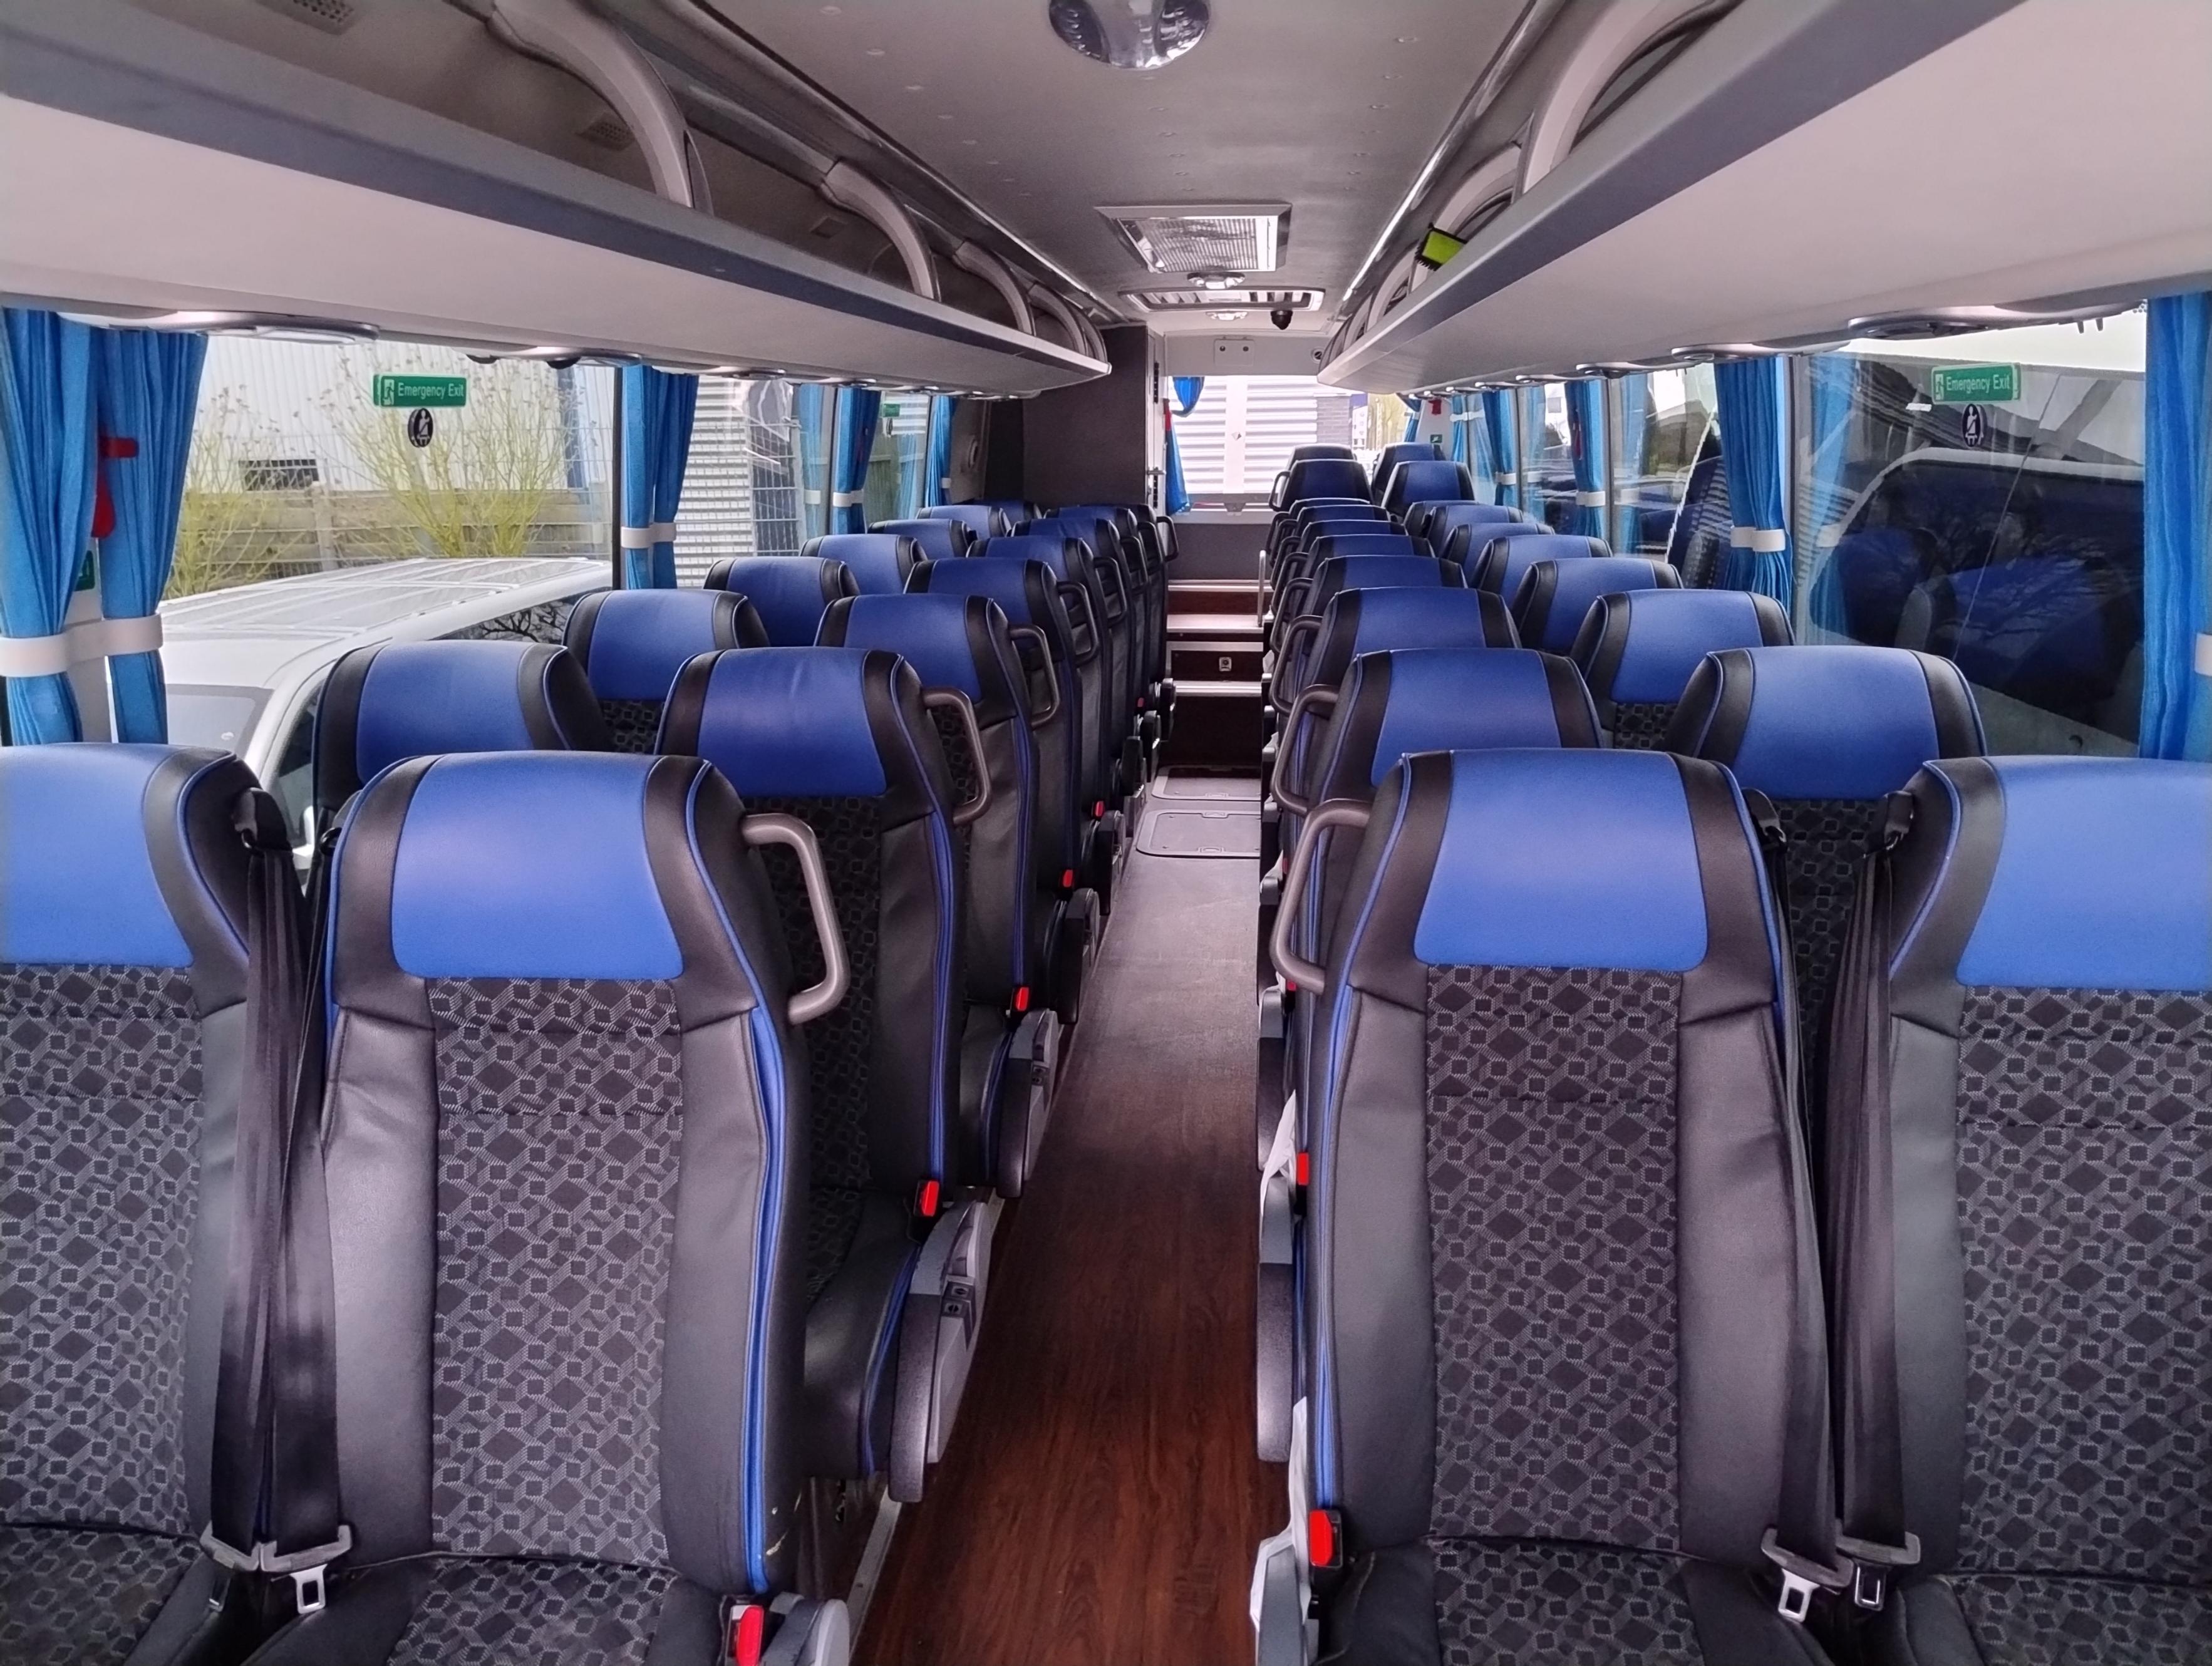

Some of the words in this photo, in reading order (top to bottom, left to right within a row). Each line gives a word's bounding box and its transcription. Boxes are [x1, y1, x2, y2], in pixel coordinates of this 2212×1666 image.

[398, 382, 446, 400] Emergency
[448, 383, 464, 396] Exit
[1946, 376, 1990, 393] Emergency
[1993, 374, 2010, 390] Exit
